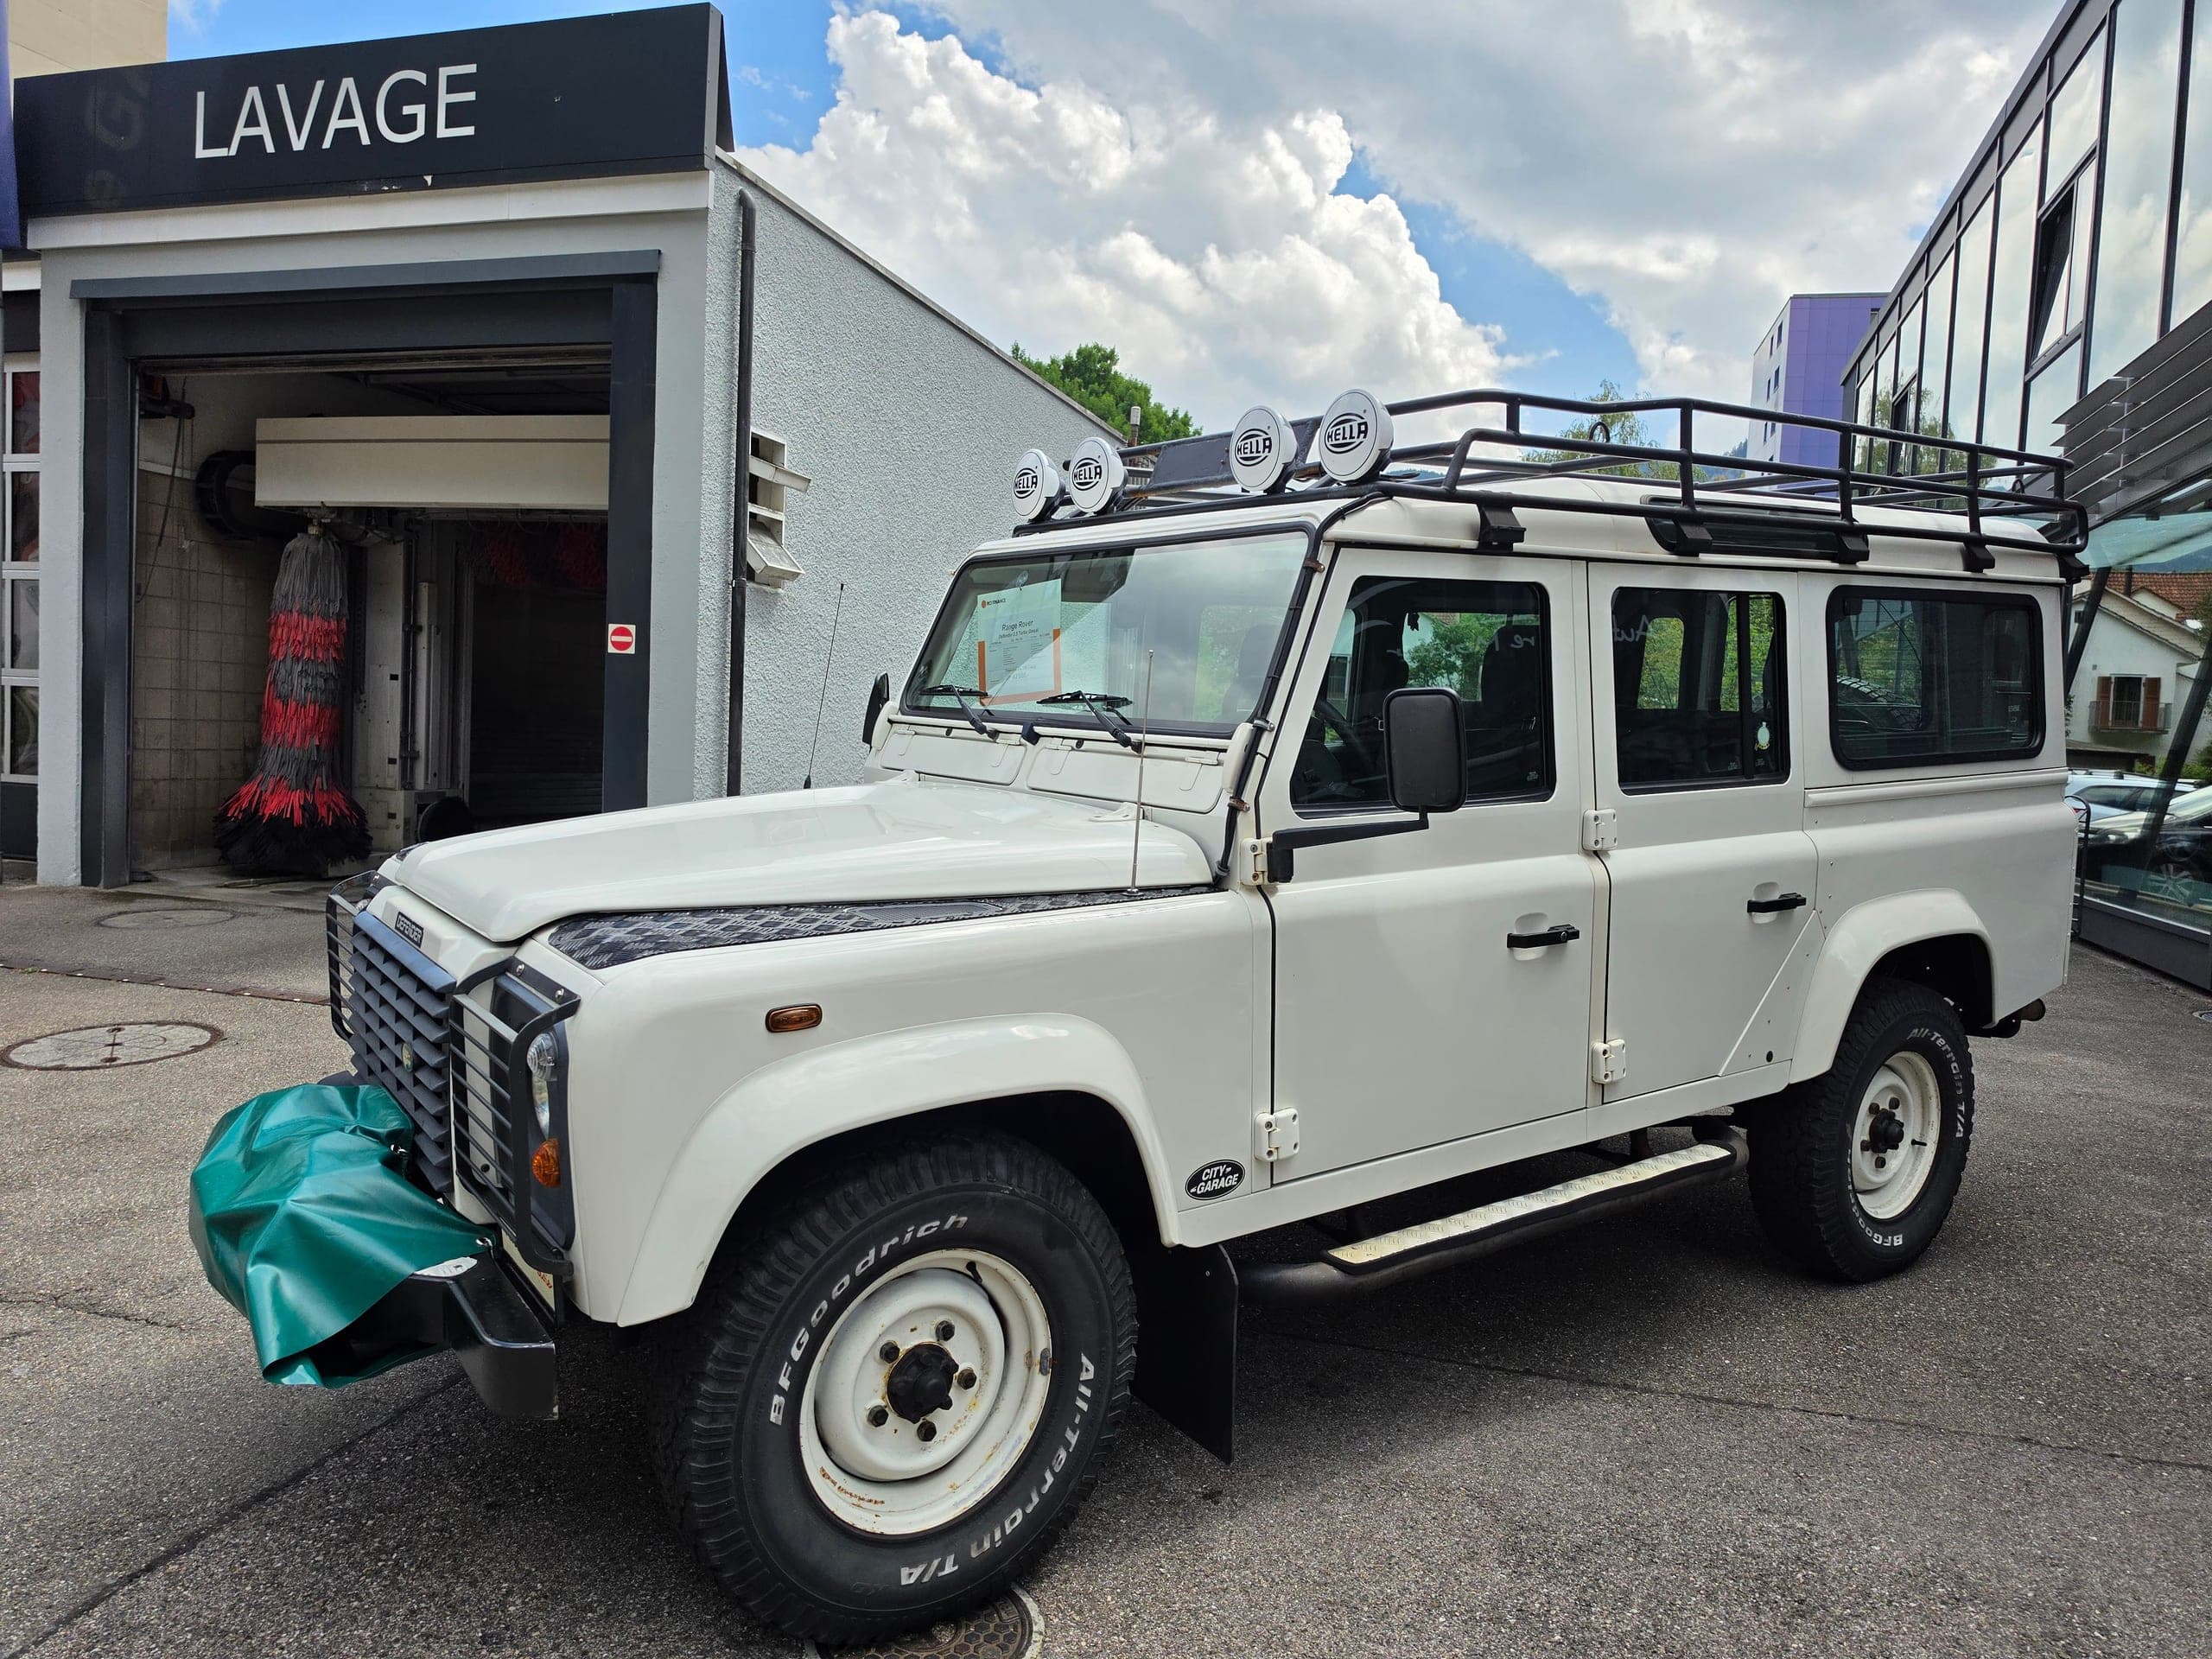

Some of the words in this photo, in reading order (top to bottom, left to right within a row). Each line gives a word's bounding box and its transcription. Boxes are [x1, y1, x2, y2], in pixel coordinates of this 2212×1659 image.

[194, 63, 477, 159] LAVAGE
[1327, 421, 1369, 443] HELLA
[1236, 436, 1273, 456] HELLA
[1014, 474, 1039, 490] HELLA
[1073, 464, 1103, 482] HELLA
[1002, 623, 1018, 632] Range
[396, 915, 423, 944] DEFENDER
[1906, 1027, 1963, 1095] All-Terrain
[1955, 1101, 1965, 1138] T/A
[1202, 1164, 1227, 1181] CITY
[1196, 1173, 1239, 1195] GARAGE
[769, 1213, 969, 1426] BFGoodrich
[970, 1352, 1095, 1559] All-Terrain
[899, 1554, 959, 1586] T/A
